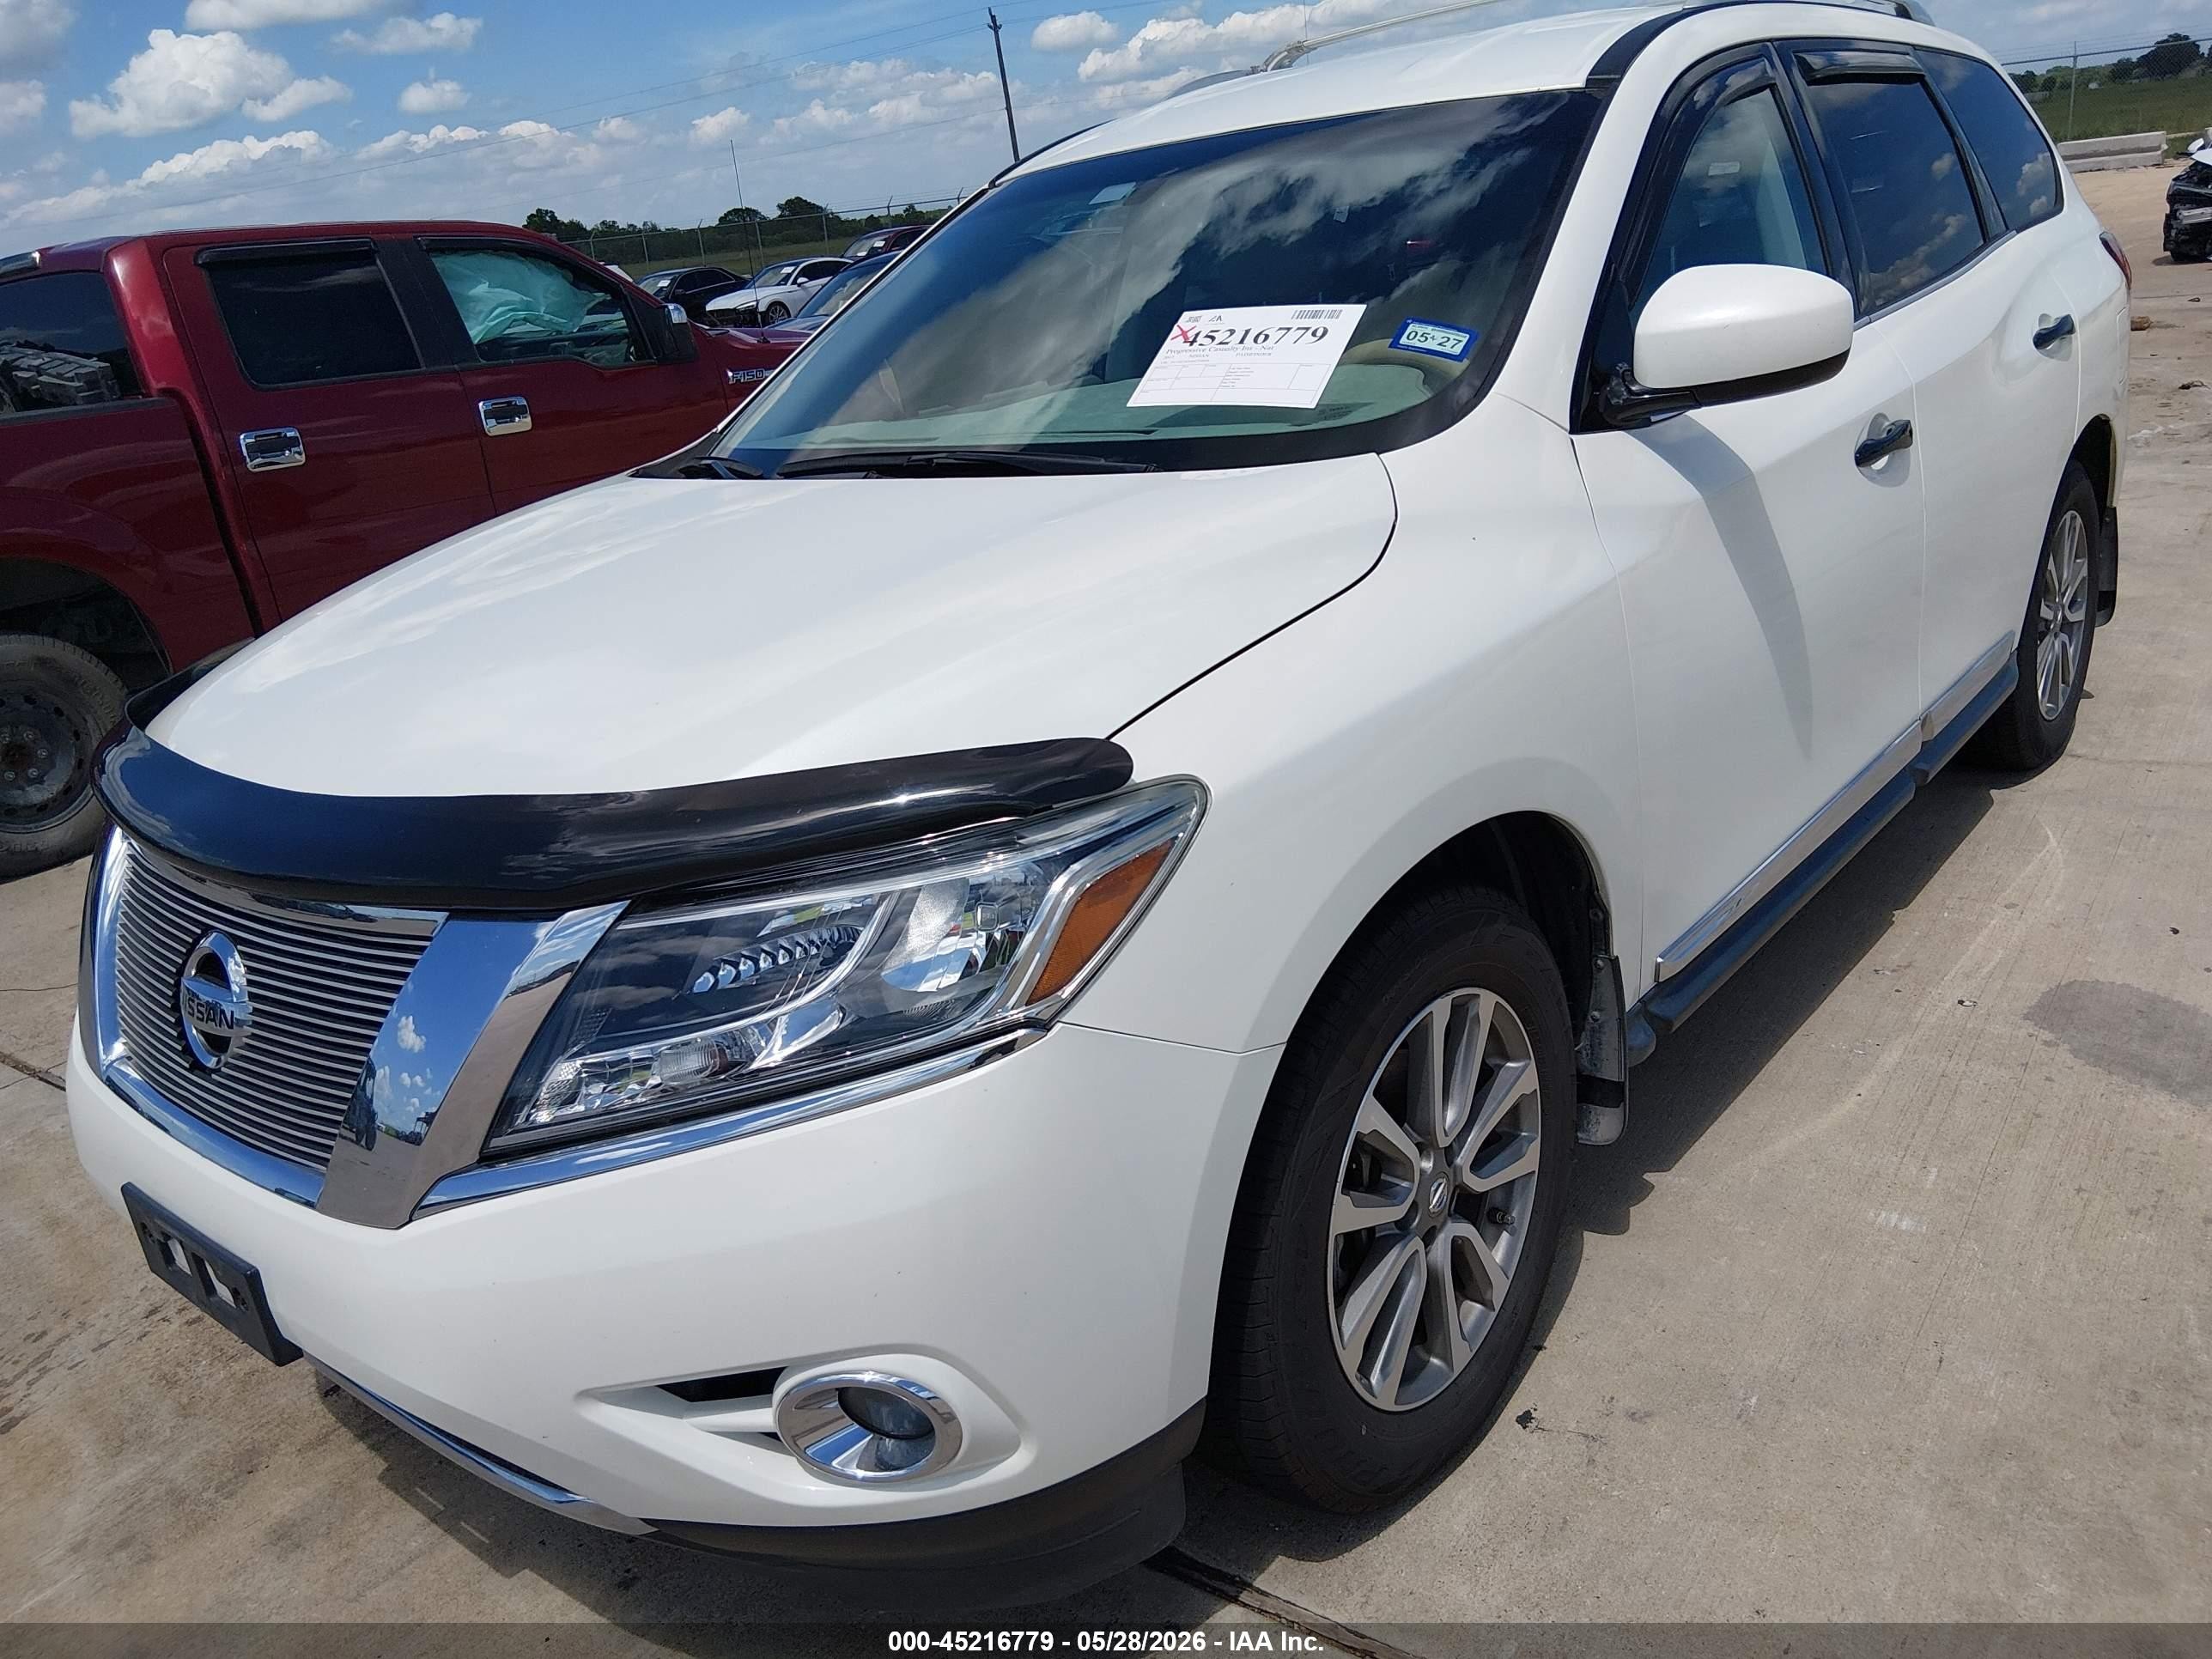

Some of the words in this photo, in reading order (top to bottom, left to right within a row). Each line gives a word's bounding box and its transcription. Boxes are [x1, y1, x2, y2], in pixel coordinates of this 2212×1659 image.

[1183, 325, 1329, 347] 45216779
[1407, 331, 1429, 343] 05
[1437, 336, 1463, 349] 27
